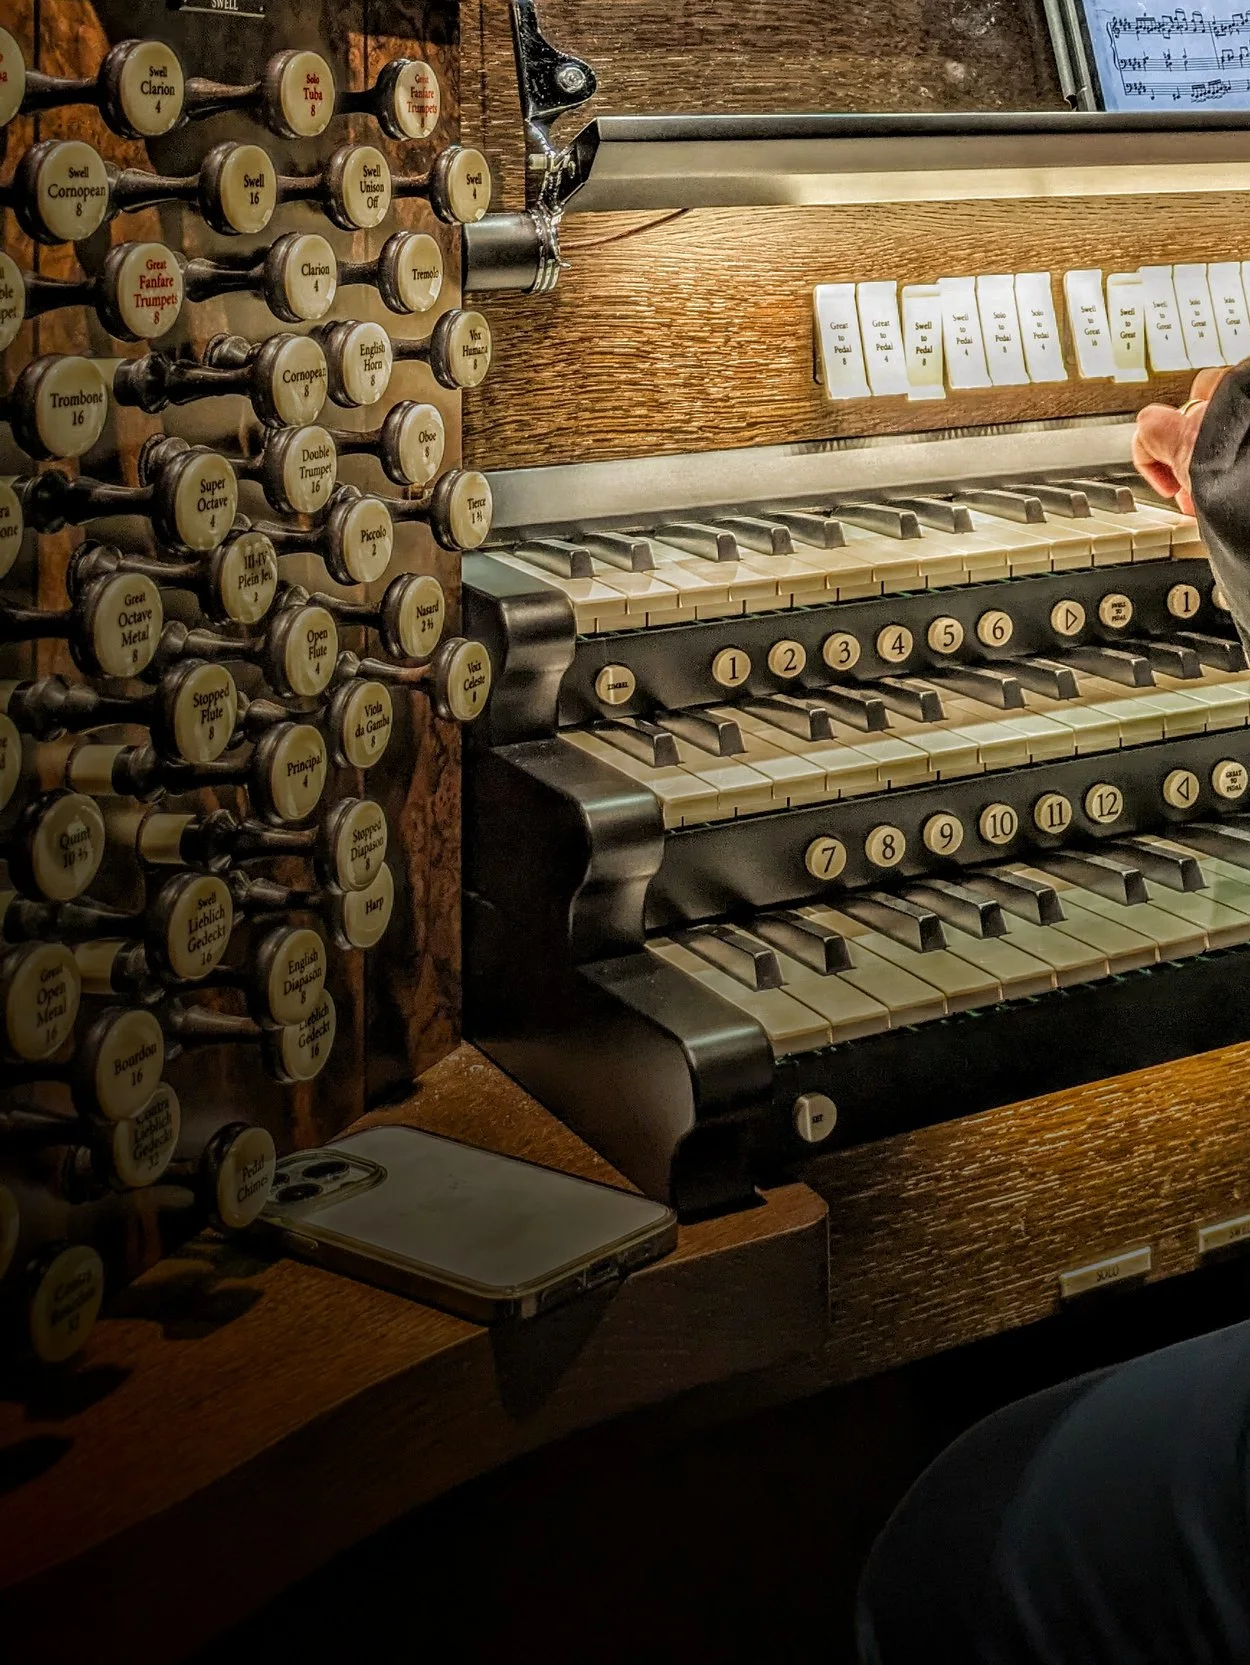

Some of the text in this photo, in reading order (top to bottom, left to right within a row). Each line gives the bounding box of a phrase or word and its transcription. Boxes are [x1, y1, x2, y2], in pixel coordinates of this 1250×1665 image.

[149, 66, 168, 78] Swell
[306, 74, 320, 85] Solo
[140, 81, 175, 96] Clarion
[303, 88, 323, 102] Tuba
[410, 87, 434, 99] Fanfare
[155, 103, 161, 114] 4
[310, 105, 316, 117] 8
[406, 101, 437, 117] Trumpets
[68, 167, 89, 178] Swell
[363, 165, 381, 178] Swell
[243, 175, 265, 188] Swell
[360, 181, 384, 193] Unison
[466, 174, 482, 186] Swell
[48, 184, 106, 202] Cornopean
[250, 191, 260, 206] 16
[472, 189, 477, 200] 4
[367, 195, 379, 209] Off
[76, 203, 82, 217] 8
[146, 259, 167, 271] Great
[301, 263, 330, 277] Clarion
[139, 273, 174, 289] Fanfare
[412, 267, 439, 281] Tremolo
[314, 280, 319, 292] 4
[134, 294, 178, 313] Trumpets
[1080, 305, 1097, 313] Swell
[154, 311, 160, 325] 8
[952, 314, 969, 322] Swell
[1120, 308, 1135, 317] Swell
[830, 321, 849, 330] Great
[872, 320, 890, 328] Great
[915, 321, 932, 330] Swell
[1084, 327, 1100, 336] Great
[1156, 322, 1172, 330] Great
[838, 334, 845, 342] to
[956, 337, 973, 345] Pedal
[995, 334, 1011, 342] Pedal
[1120, 330, 1136, 339] Great
[360, 341, 386, 358] English
[834, 345, 852, 354] Pedal
[876, 342, 893, 351] Pedal
[916, 345, 932, 354] Pedal
[364, 359, 383, 372] Horn
[474, 358, 478, 370] 8
[842, 357, 847, 366] 8
[884, 355, 889, 363] 4
[922, 358, 926, 366] 8
[282, 367, 326, 383] Cornopean
[370, 374, 376, 387] 8
[50, 389, 103, 408] Trombone
[304, 385, 309, 397] 8
[72, 411, 84, 426] 16
[418, 431, 437, 445] Oboe
[302, 445, 330, 462] Double
[299, 462, 332, 479] Trumpet
[200, 478, 226, 495] Super
[311, 481, 320, 494] 16
[197, 496, 228, 513] Octave
[467, 497, 486, 510] Tierce
[210, 514, 216, 529] 4
[361, 528, 387, 544] Piccolo
[371, 544, 377, 556] 2
[238, 573, 259, 590] Plein
[124, 592, 146, 607] Great
[1183, 591, 1190, 612] 1
[416, 599, 439, 618] Nasard
[118, 609, 153, 627] Octave
[943, 625, 955, 647] 5
[992, 617, 1005, 640] 6
[121, 628, 150, 648] Metal
[307, 629, 328, 646] Open
[891, 633, 905, 655] 4
[132, 649, 138, 663] 8
[308, 645, 328, 660] Flute
[839, 641, 851, 663] 3
[784, 648, 797, 672] 2
[315, 663, 320, 675] 4
[728, 656, 739, 680] 1
[463, 675, 486, 691] Celeste
[193, 682, 230, 709] Stopped
[201, 706, 224, 725] Flute
[364, 700, 383, 716] Viola
[208, 725, 215, 740] 8
[355, 725, 365, 738] da
[370, 735, 376, 748] 8
[286, 750, 323, 776] Principal
[302, 775, 309, 788] 4
[1096, 792, 1119, 817] 12
[1047, 801, 1064, 828] 11
[352, 820, 382, 844] Stopped
[990, 811, 1014, 838] 10
[940, 823, 954, 848] 9
[350, 836, 384, 863] Diapason
[881, 834, 895, 860] 8
[365, 857, 371, 871] 8
[821, 846, 836, 873] 7
[197, 891, 216, 910] Swell
[365, 895, 384, 915] Harp
[188, 904, 225, 934] Lieblich
[187, 924, 225, 952] Gedeckt
[201, 950, 212, 965] 16
[288, 948, 319, 975] English
[283, 967, 322, 996] Diapason
[301, 991, 306, 1004] 8
[311, 1043, 319, 1059] 16
[113, 1043, 157, 1076] Bourdon
[131, 1067, 143, 1087] 16
[243, 1154, 265, 1182] Pedal
[237, 1176, 269, 1203] Chimes
[1096, 1265, 1120, 1281] SOLO
